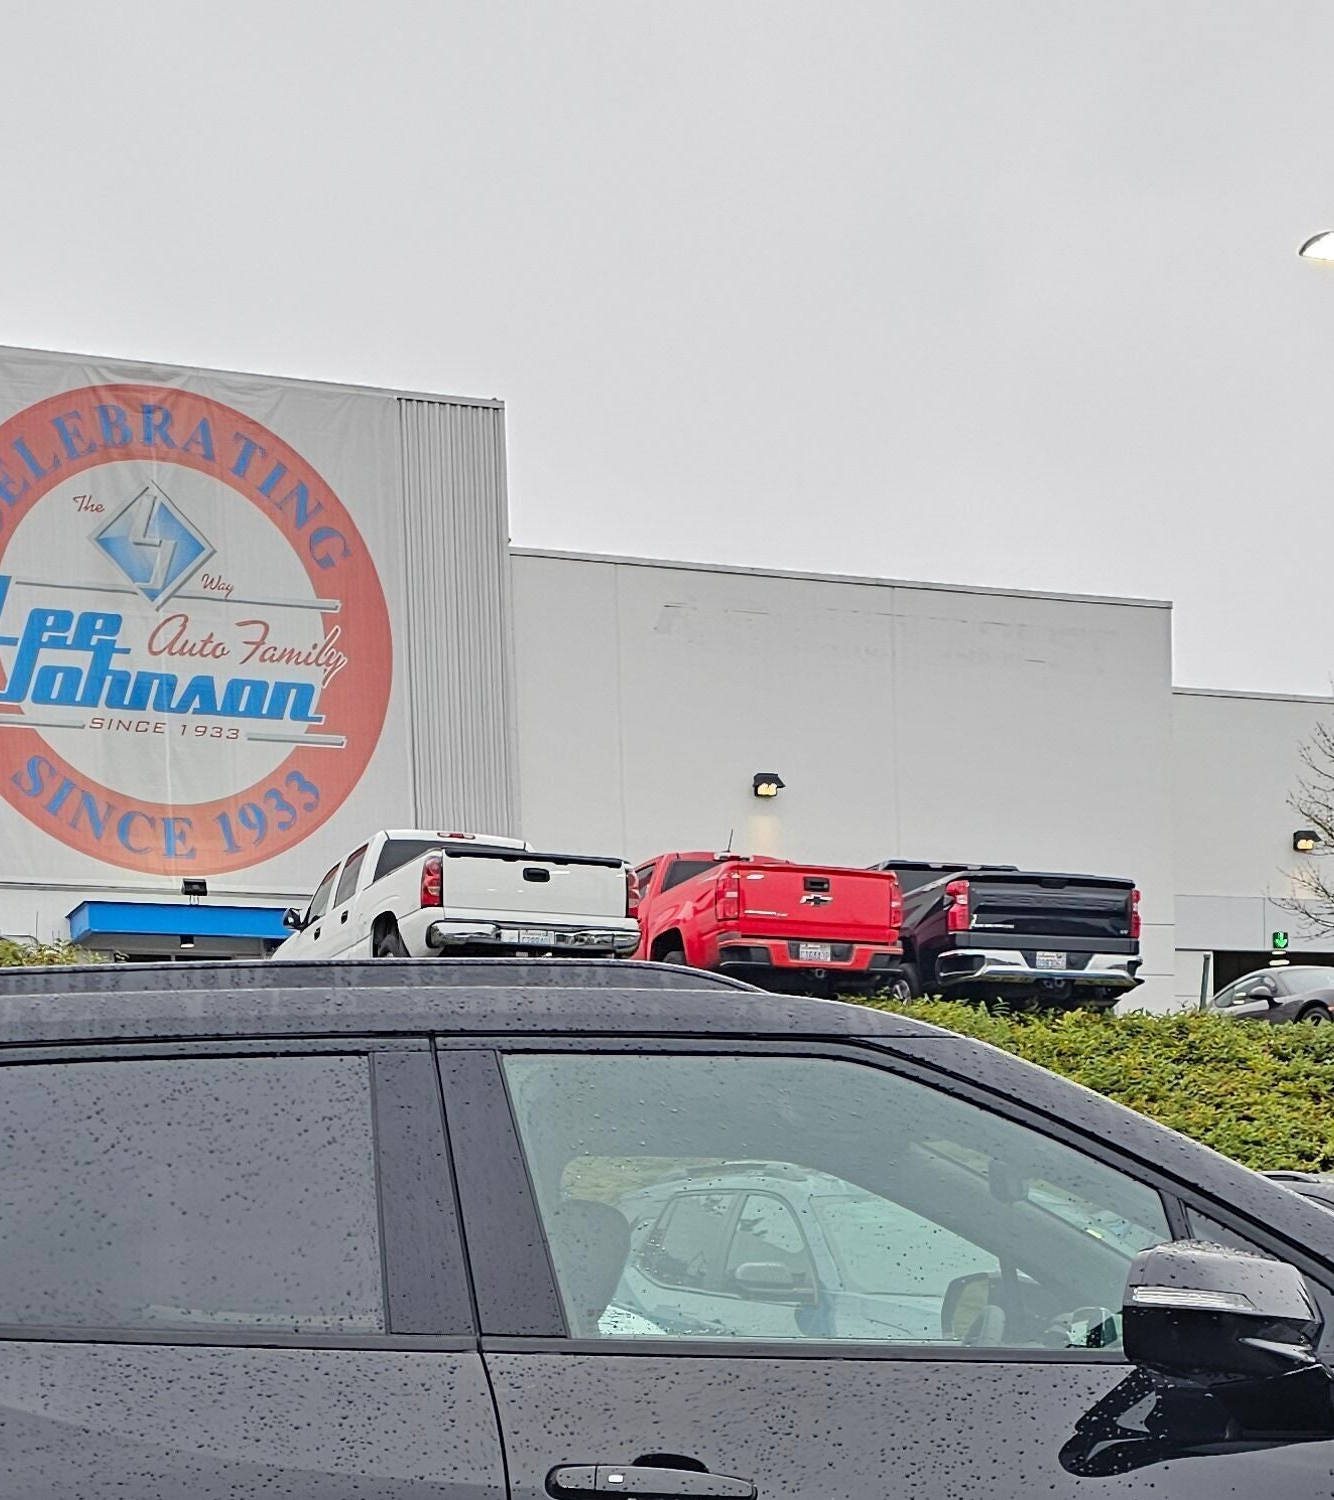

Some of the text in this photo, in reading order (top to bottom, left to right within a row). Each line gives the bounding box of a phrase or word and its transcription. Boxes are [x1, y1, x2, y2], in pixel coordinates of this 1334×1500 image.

[73, 495, 106, 513] The
[201, 573, 235, 598] Way
[148, 613, 230, 659] Auto
[234, 618, 348, 686] Family
[88, 717, 240, 741] SINCE 1933
[10, 754, 322, 860] SINCE 1933
